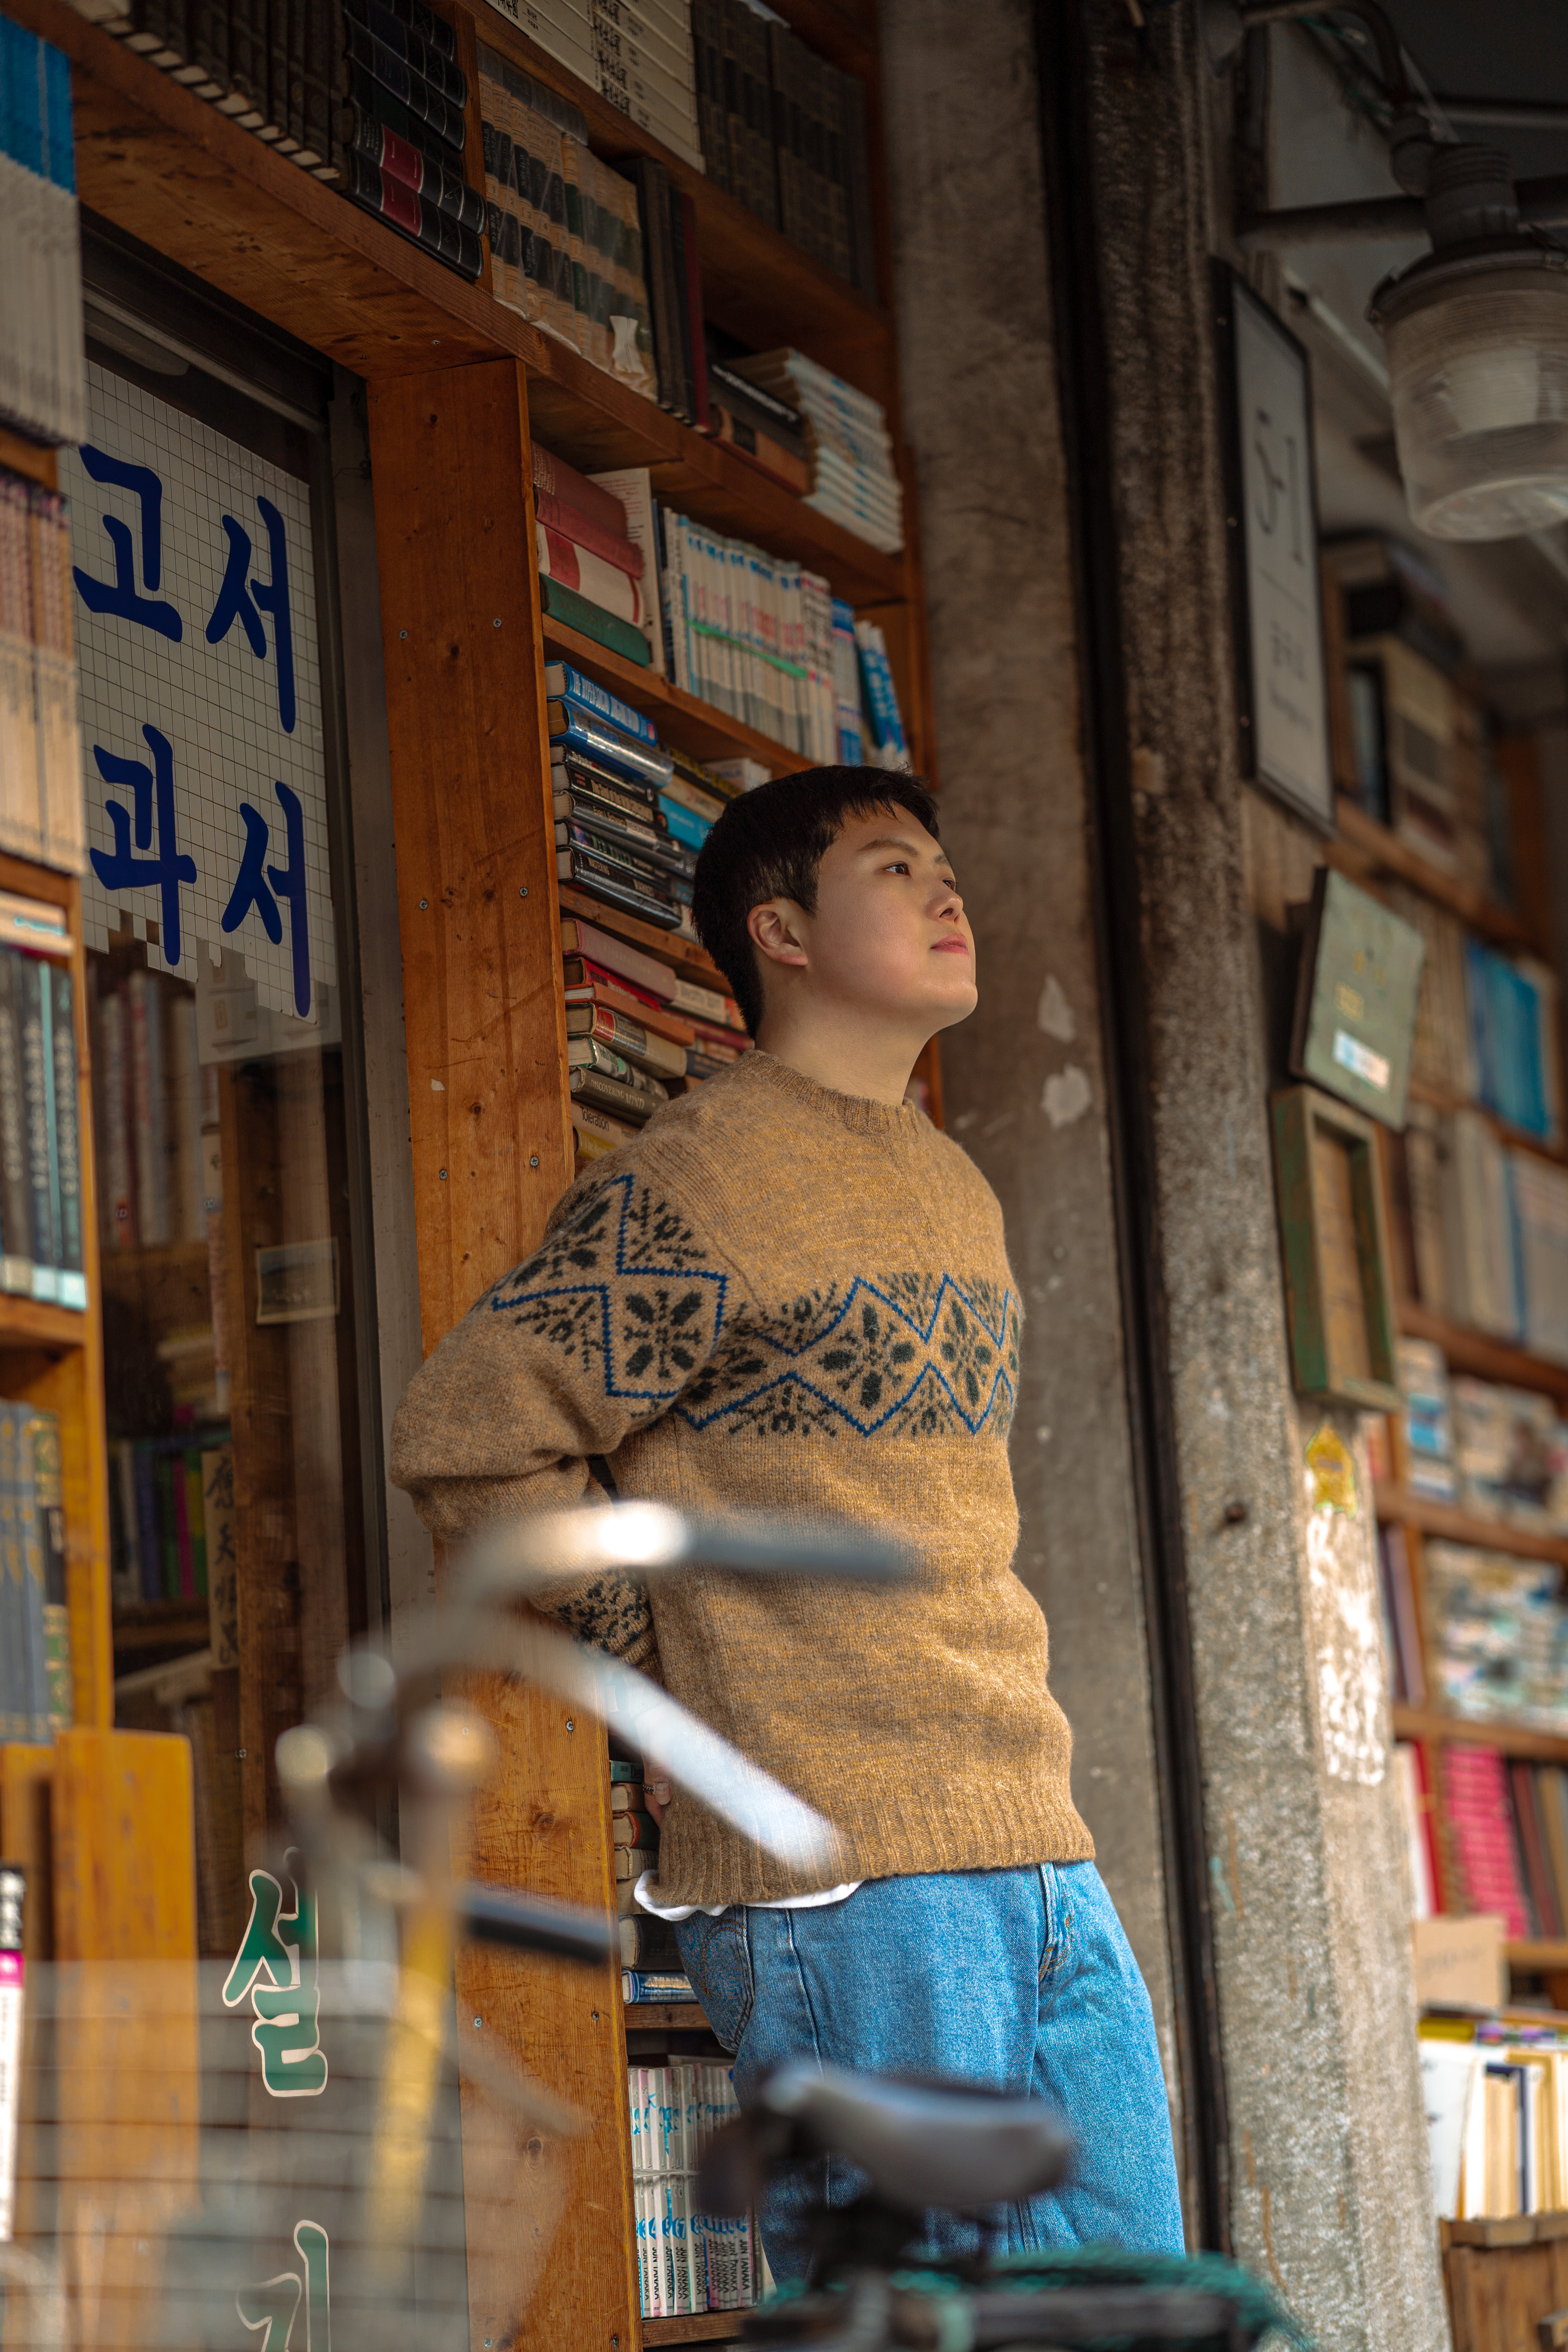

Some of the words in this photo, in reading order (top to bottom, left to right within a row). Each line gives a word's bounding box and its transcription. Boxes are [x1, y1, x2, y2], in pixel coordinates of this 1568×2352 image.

[72, 443, 296, 734] 고서
[591, 1079, 624, 1099] DISCOVERING
[625, 1093, 645, 1109] MIND
[580, 1106, 610, 1132] Toleration
[739, 2238, 748, 2254] JUN
[740, 2257, 750, 2290] TANAKA
